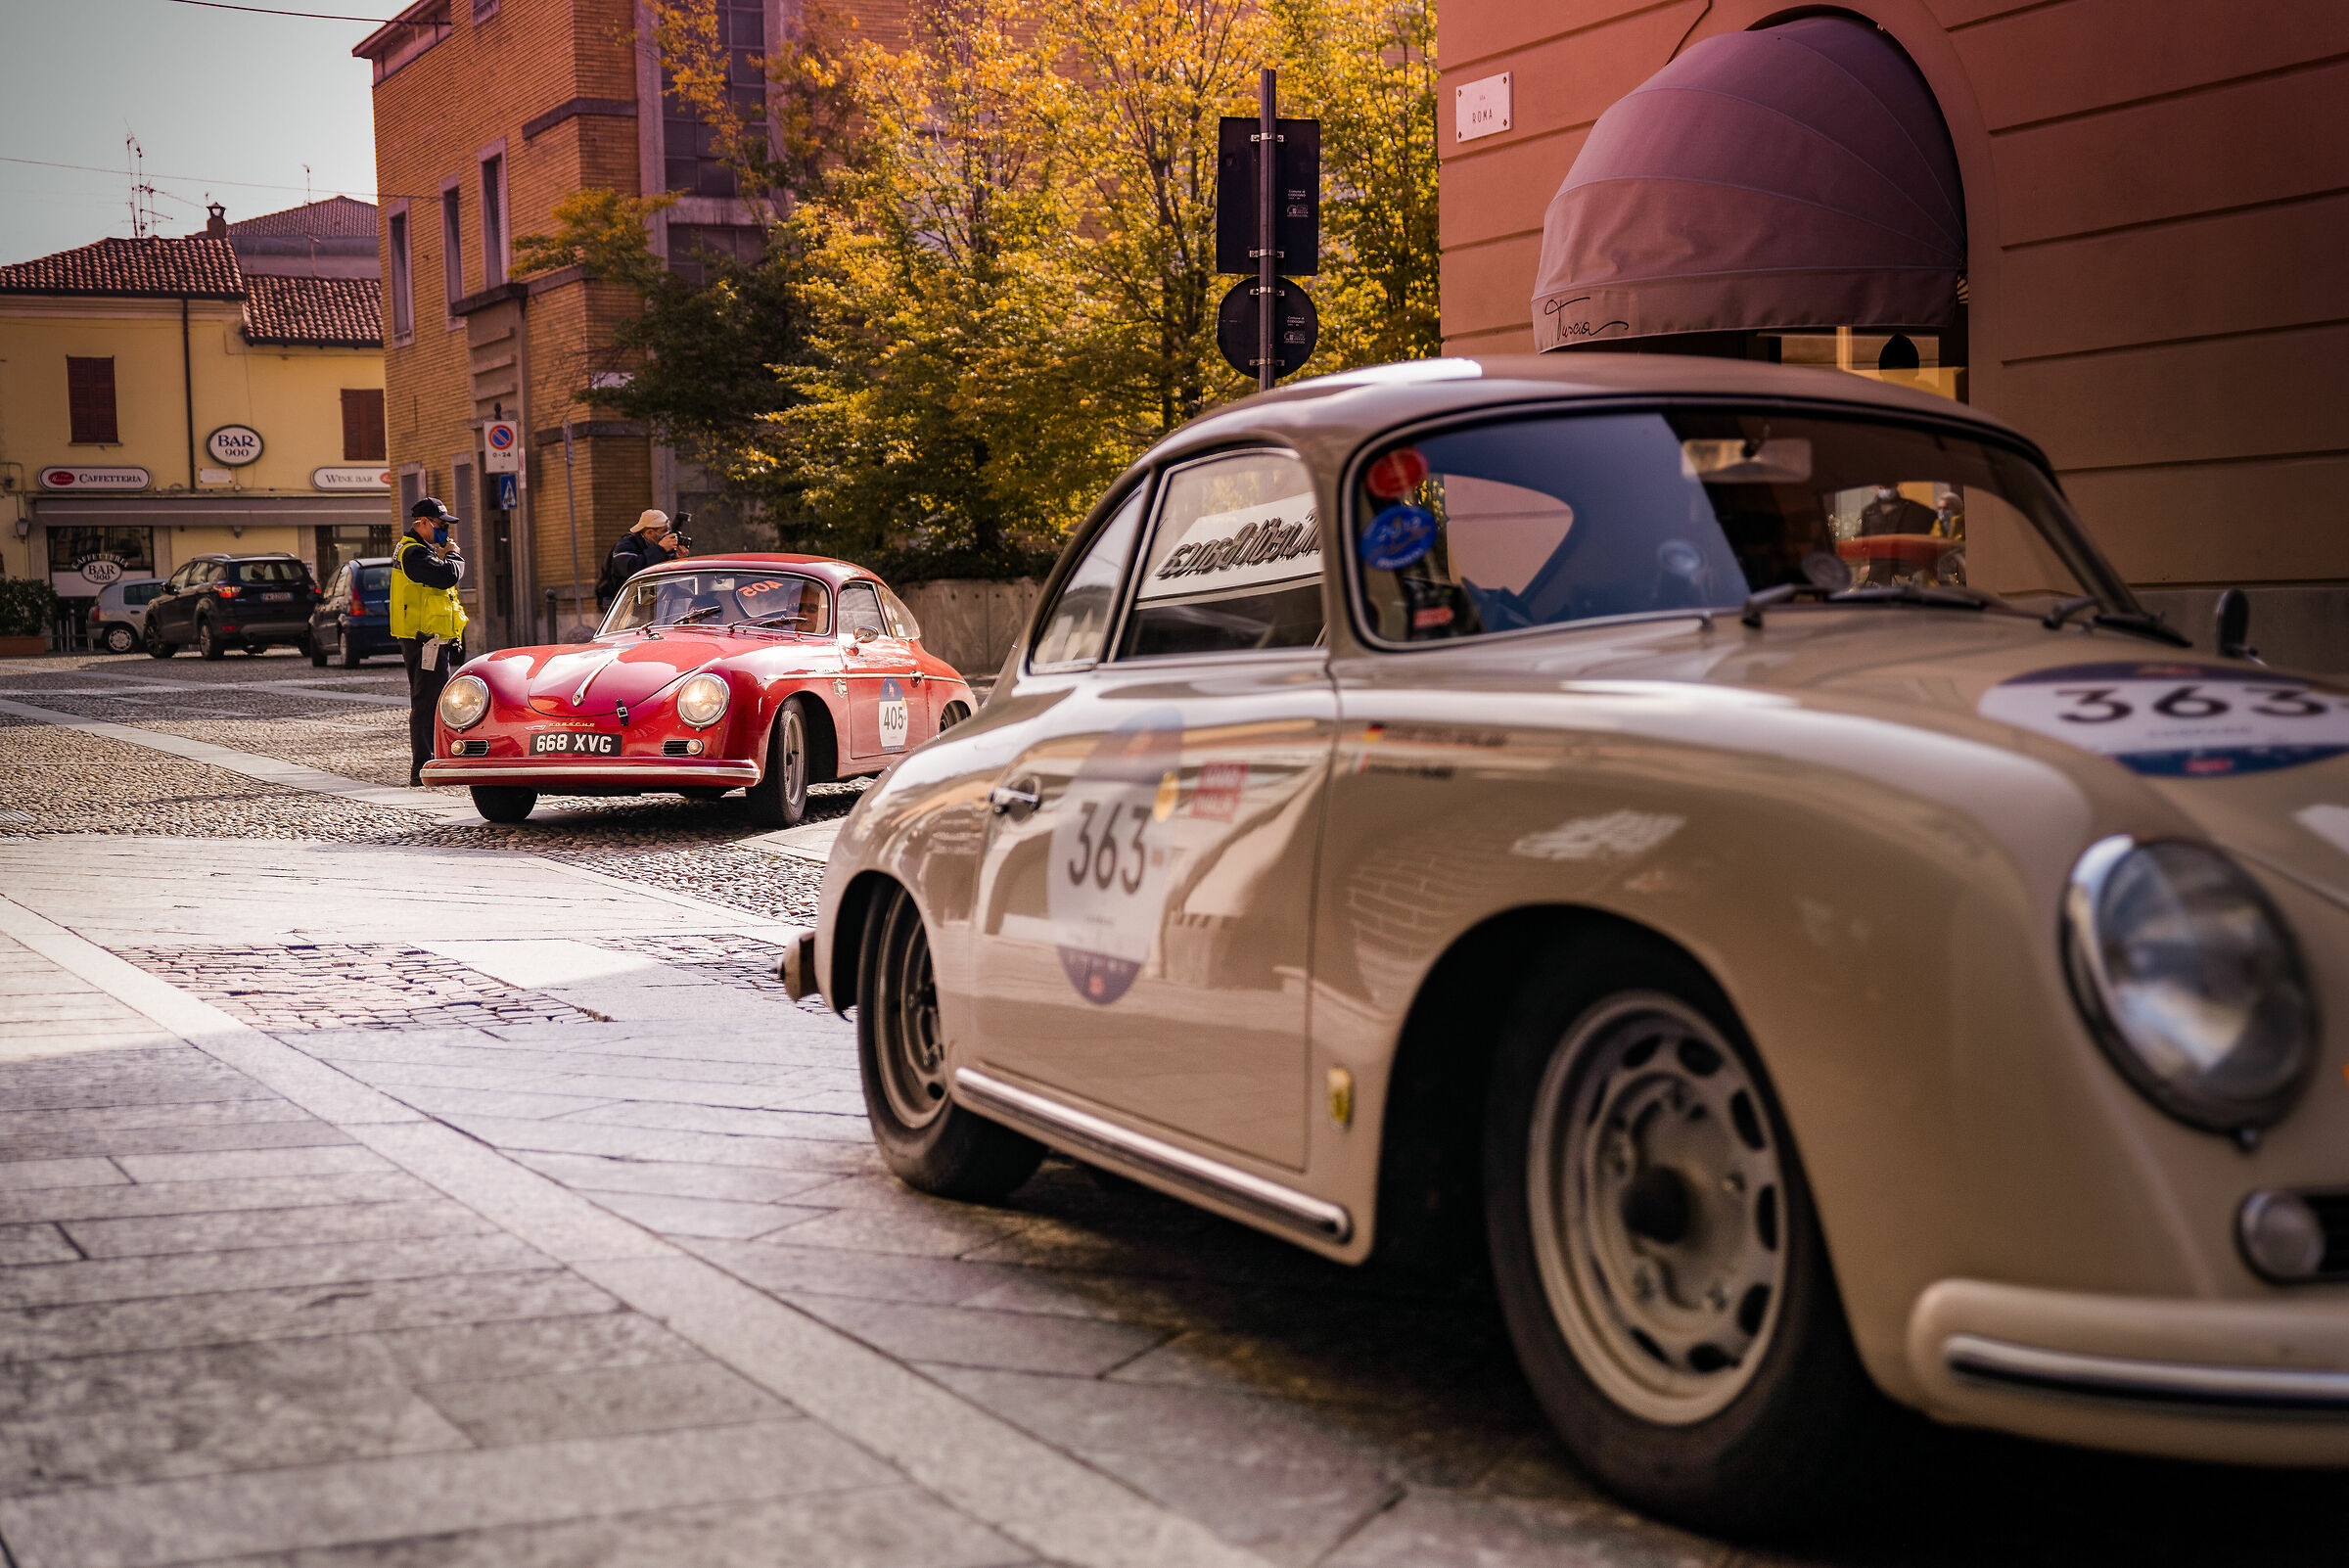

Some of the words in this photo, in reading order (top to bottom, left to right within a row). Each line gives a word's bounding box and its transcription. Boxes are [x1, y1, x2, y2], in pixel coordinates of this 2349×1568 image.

[1472, 109, 1493, 124] ROMA
[218, 435, 255, 447] BAR
[224, 448, 250, 457] 900
[79, 474, 142, 484] CAFFETTERIA
[326, 474, 352, 483] WINE
[88, 565, 115, 575] BAR
[2055, 686, 2329, 725] 363
[884, 706, 904, 730] 405
[535, 734, 568, 752] 668
[574, 734, 612, 753] XVG
[1068, 802, 1152, 895] 363
